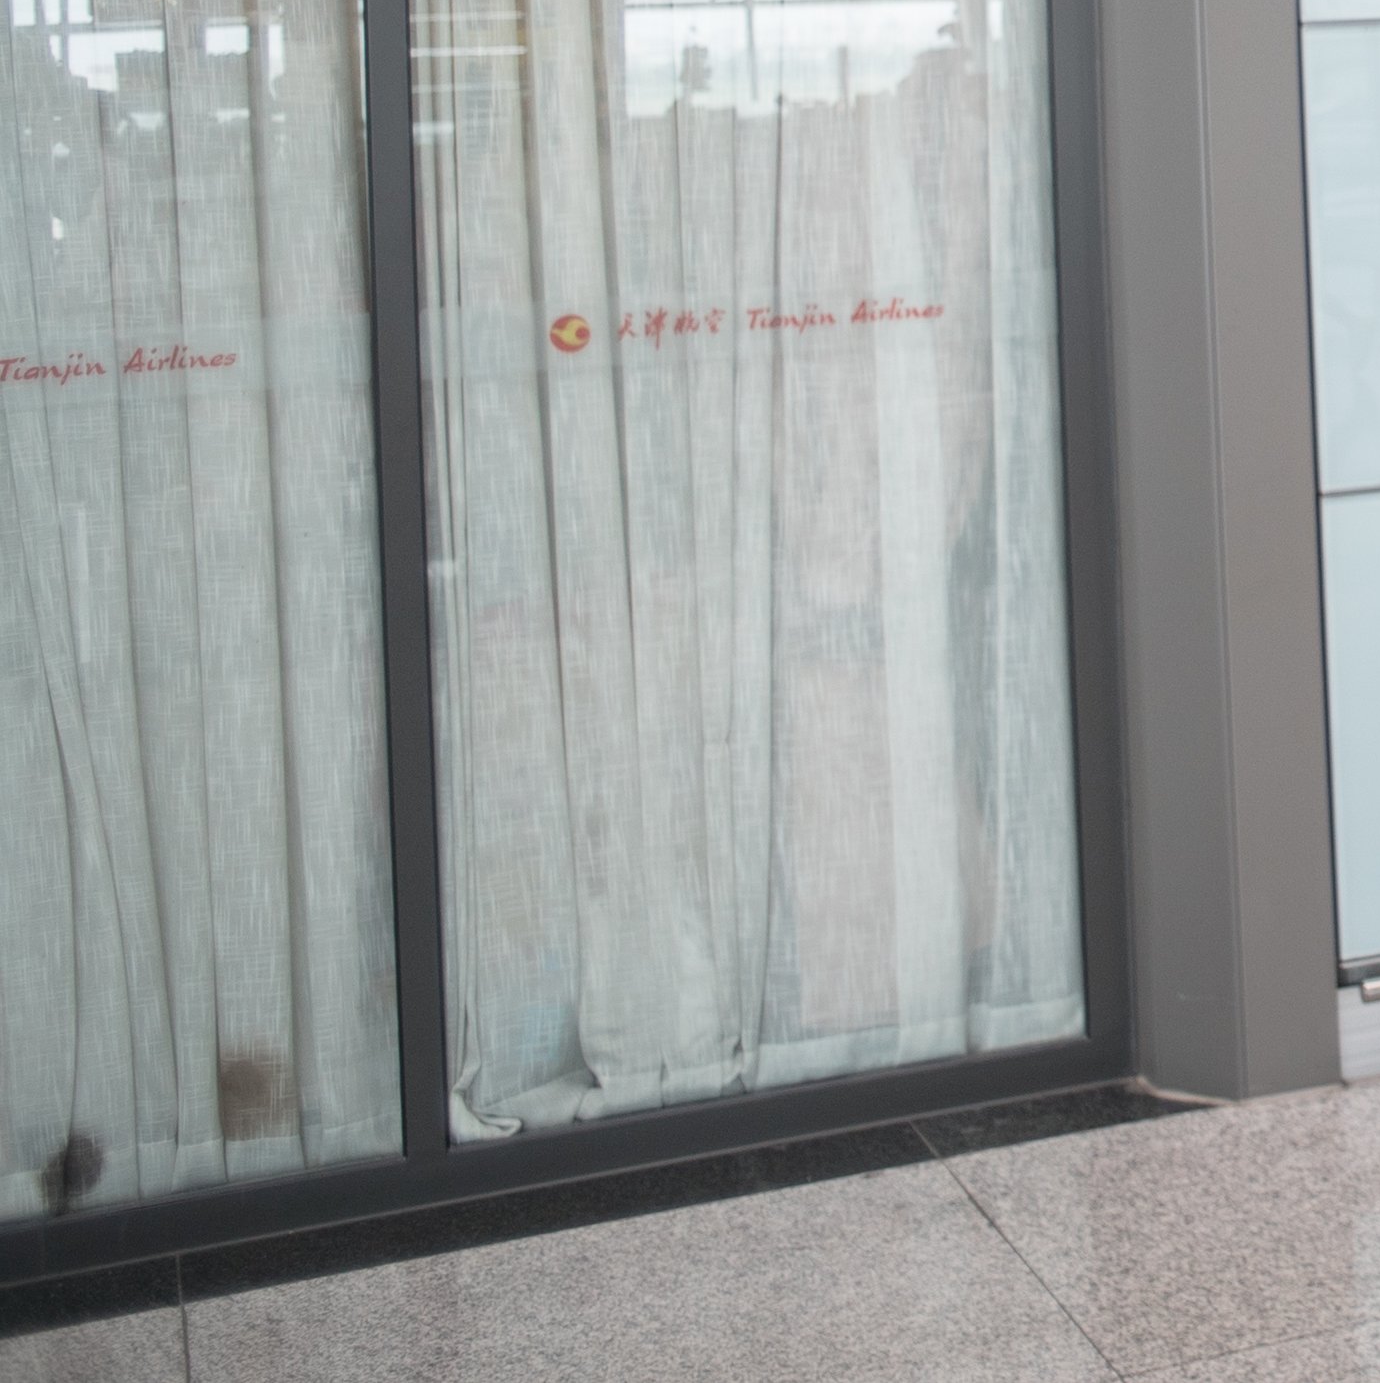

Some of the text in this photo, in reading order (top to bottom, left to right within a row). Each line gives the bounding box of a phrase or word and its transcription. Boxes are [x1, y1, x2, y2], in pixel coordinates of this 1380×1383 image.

[618, 305, 726, 350] 天津航空
[747, 297, 944, 333] Tianjin Airlines
[0, 345, 237, 385] Tianjin Airlines
